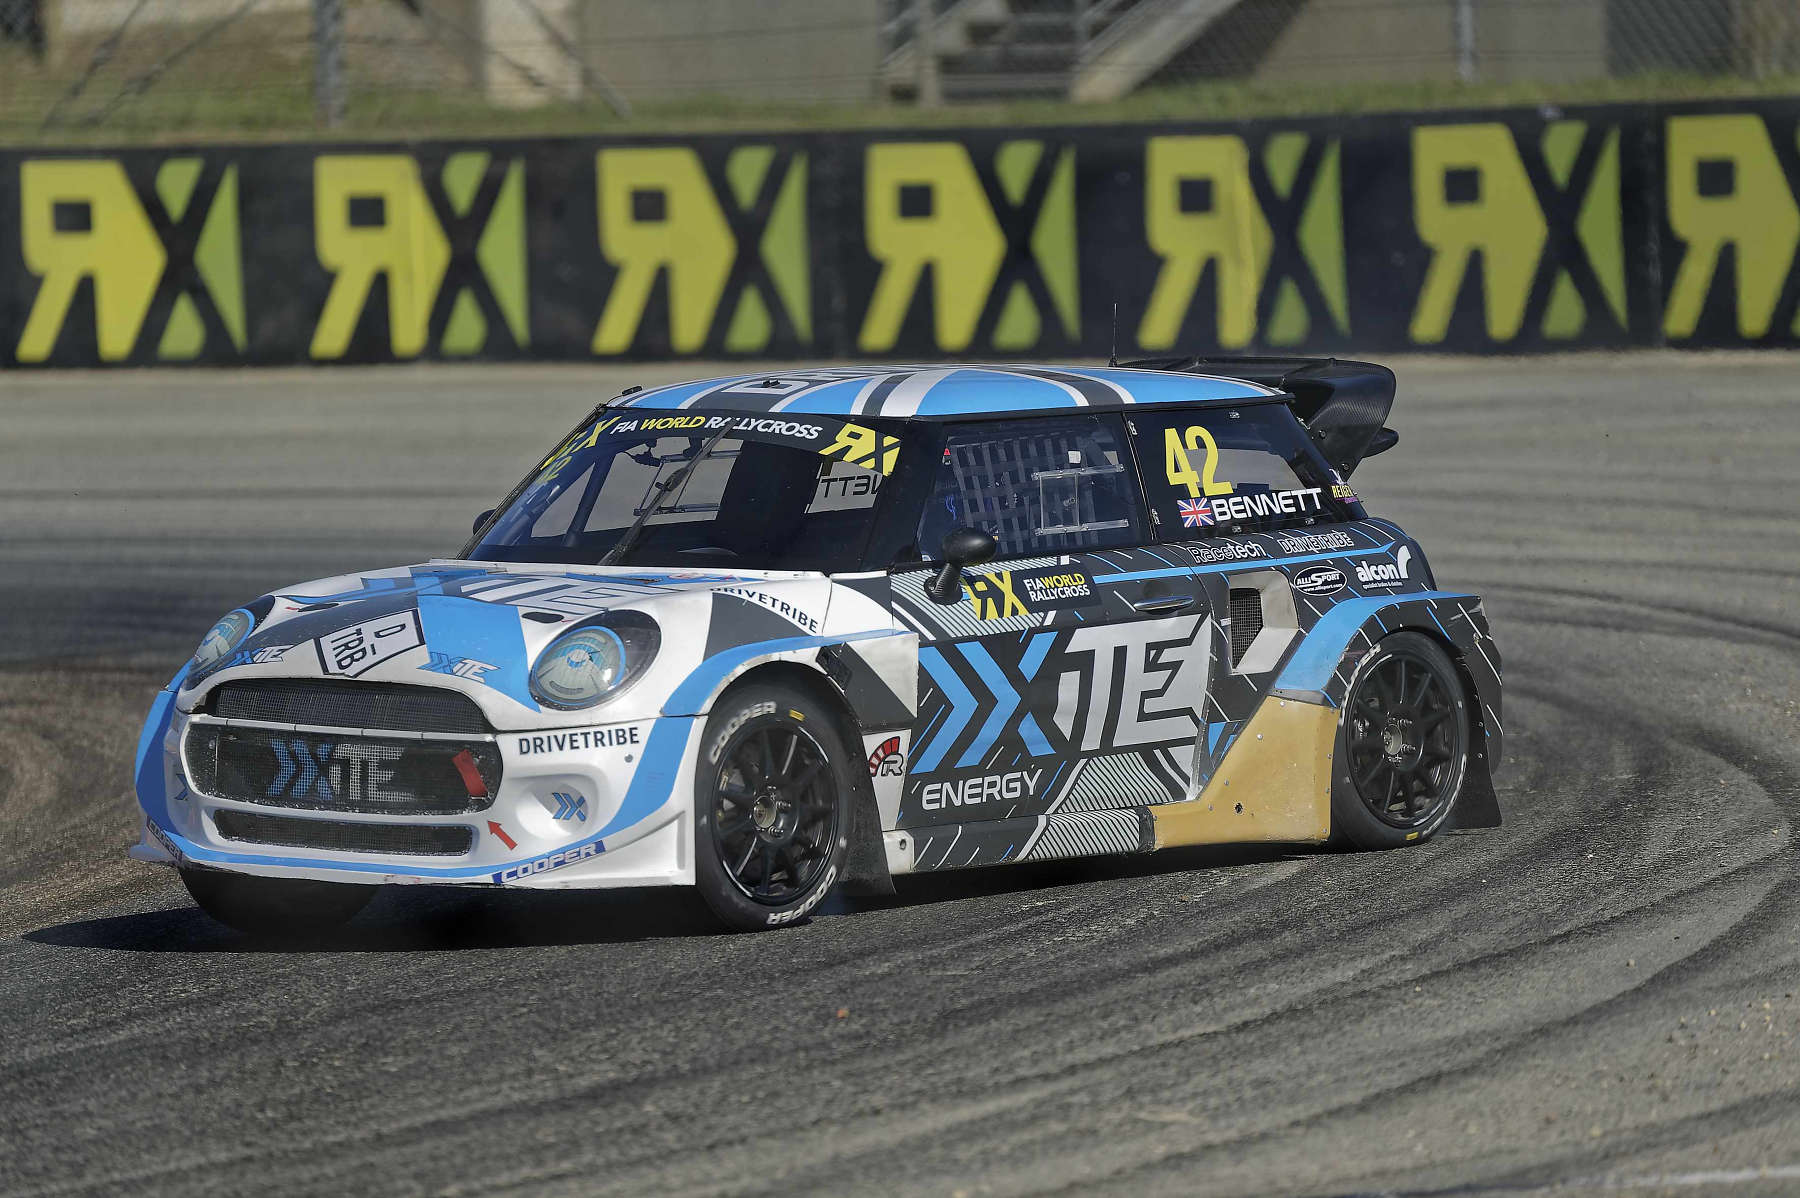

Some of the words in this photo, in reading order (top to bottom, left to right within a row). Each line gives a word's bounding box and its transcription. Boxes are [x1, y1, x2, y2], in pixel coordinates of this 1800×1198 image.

[610, 419, 639, 435] FIA
[640, 416, 706, 430] WORLD
[818, 423, 900, 476] RX
[1164, 425, 1233, 498] 42
[1210, 487, 1322, 522] BENNETT
[1187, 540, 1266, 563] Racetech
[1277, 531, 1354, 554] DRIVETRIBE
[1355, 561, 1400, 582] alcon
[709, 587, 819, 634] DRIVETRIBE
[1029, 584, 1090, 602] RALLYCROSS
[331, 627, 367, 670] TRB
[518, 727, 640, 755] DRIVETRIBE
[710, 700, 777, 765] COOPER
[922, 768, 1043, 810] ENERGY
[502, 843, 597, 883] COOPER
[766, 864, 837, 925] COOPER
